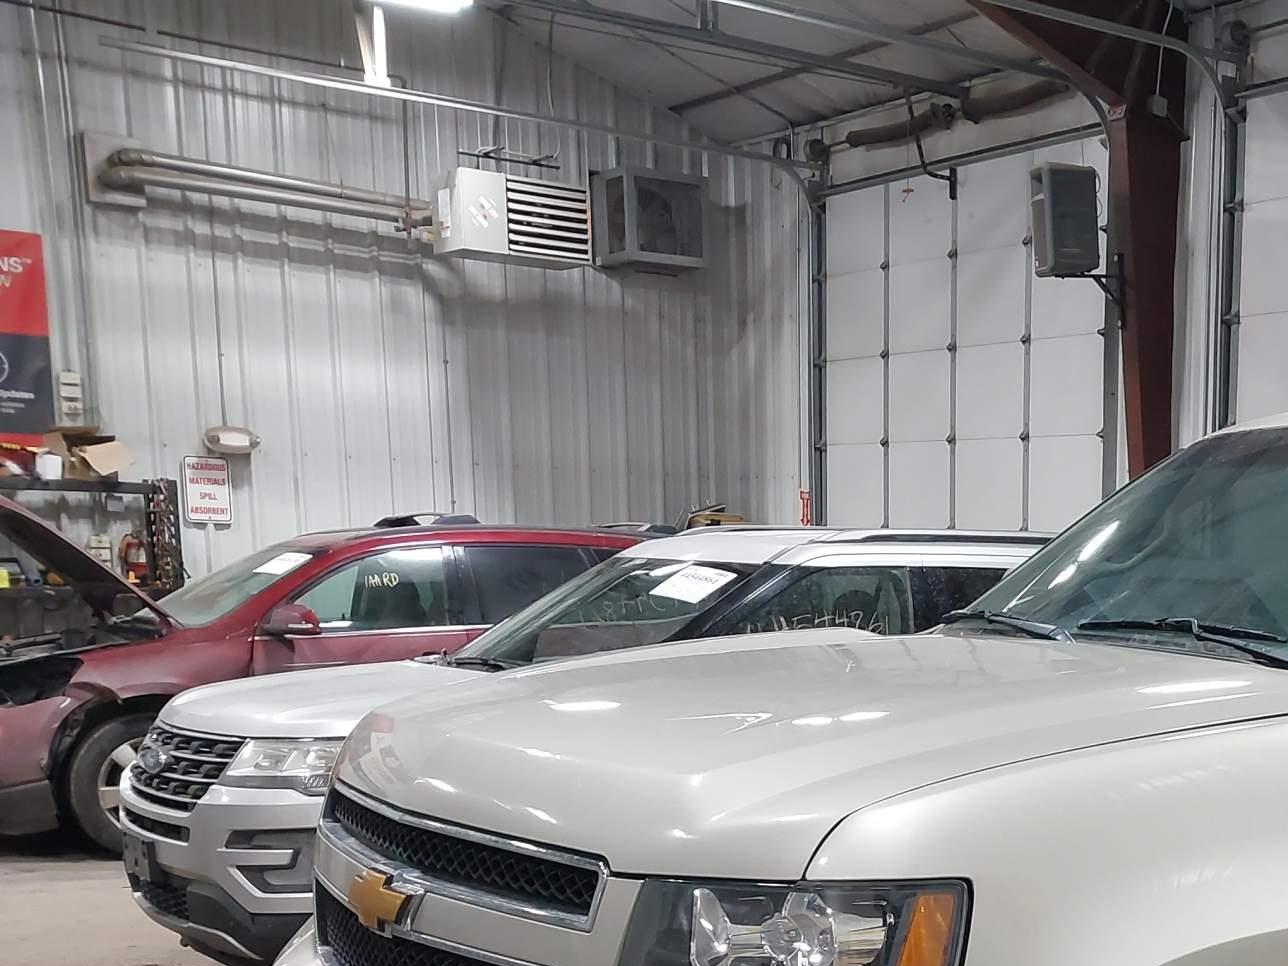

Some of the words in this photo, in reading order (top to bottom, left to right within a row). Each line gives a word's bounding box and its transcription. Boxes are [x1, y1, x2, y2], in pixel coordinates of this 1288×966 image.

[189, 476, 226, 486] MATERIALS
[200, 491, 218, 501] SPILL
[190, 506, 229, 516] ABSORBENT
